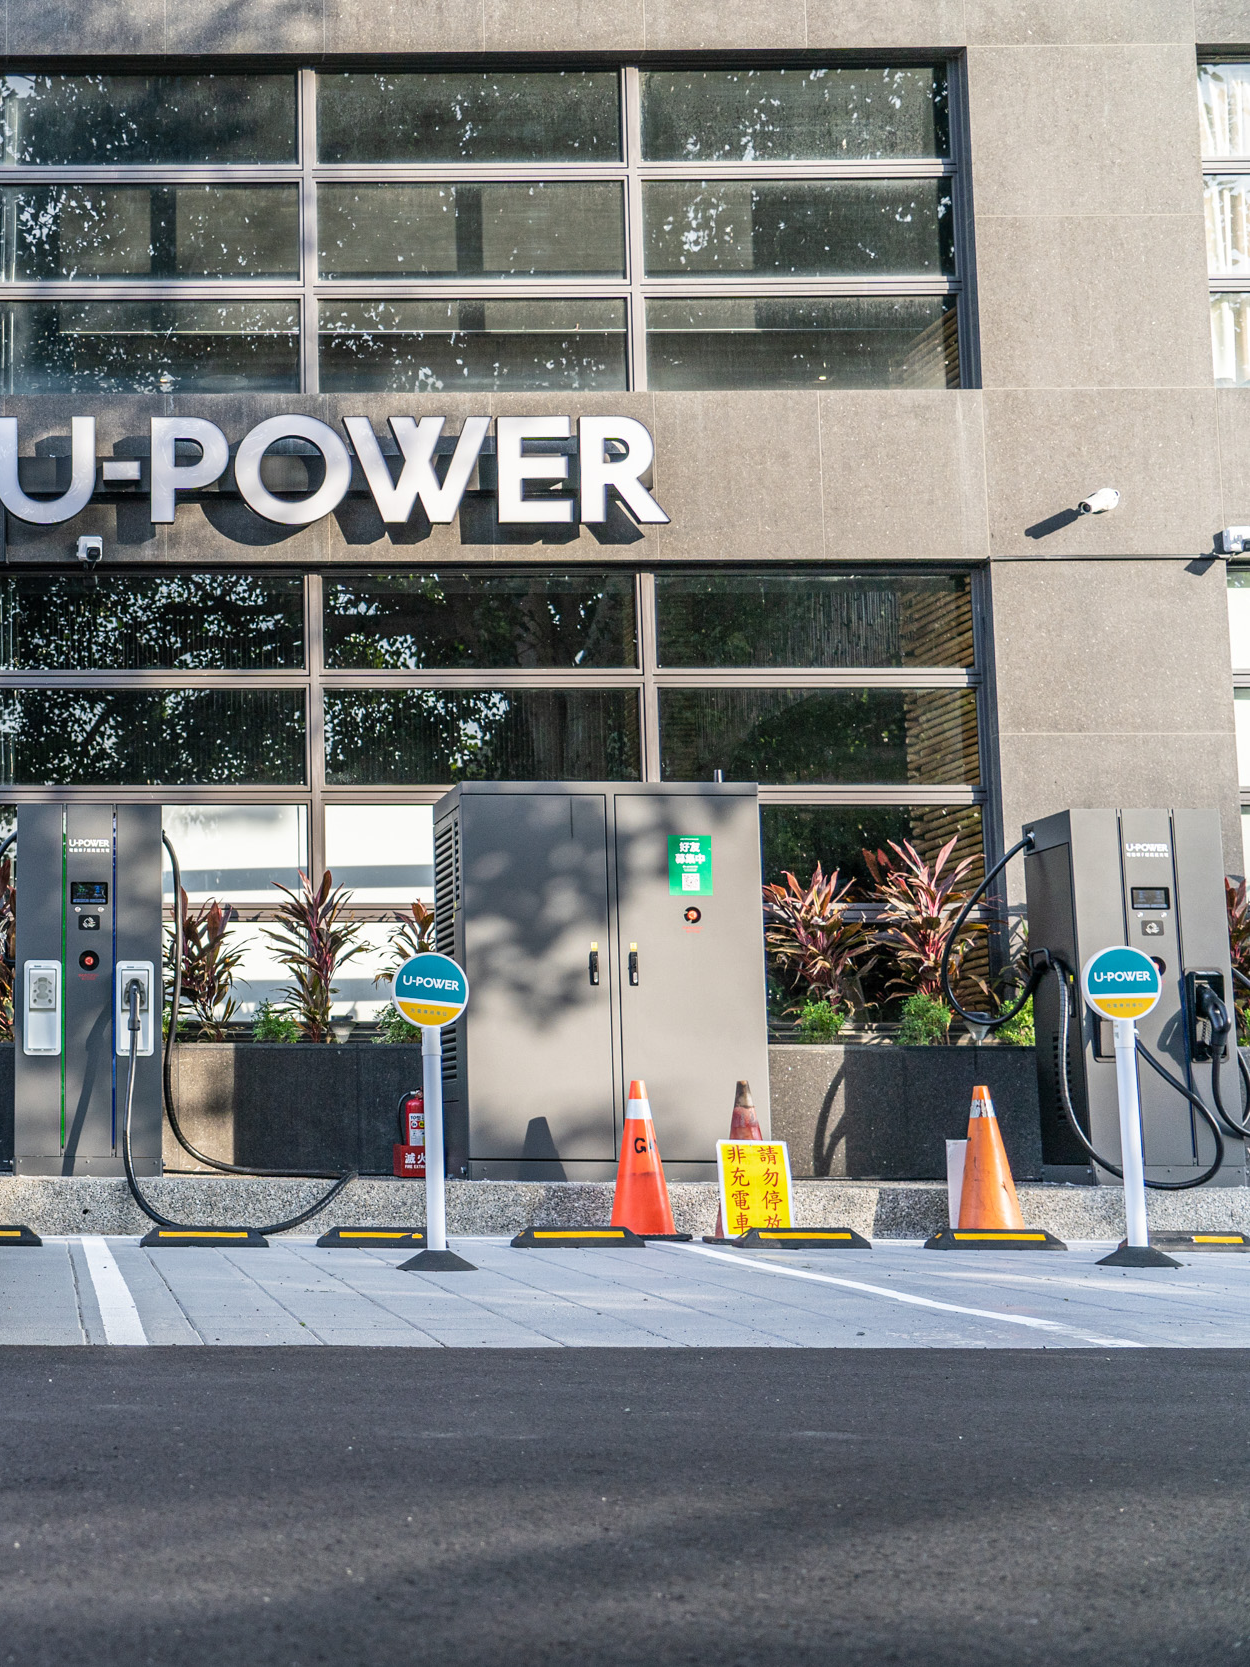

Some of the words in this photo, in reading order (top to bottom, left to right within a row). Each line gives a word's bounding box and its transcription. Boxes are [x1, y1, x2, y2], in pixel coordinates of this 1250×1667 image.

[68, 839, 110, 848] U-POWER
[679, 842, 701, 853] 好友
[1125, 843, 1169, 852] U-POWER
[402, 974, 460, 992] U-POWER
[1093, 970, 1152, 983] U-POWER
[727, 1144, 752, 1233] 非充電車
[757, 1145, 783, 1228] 請勿停放
